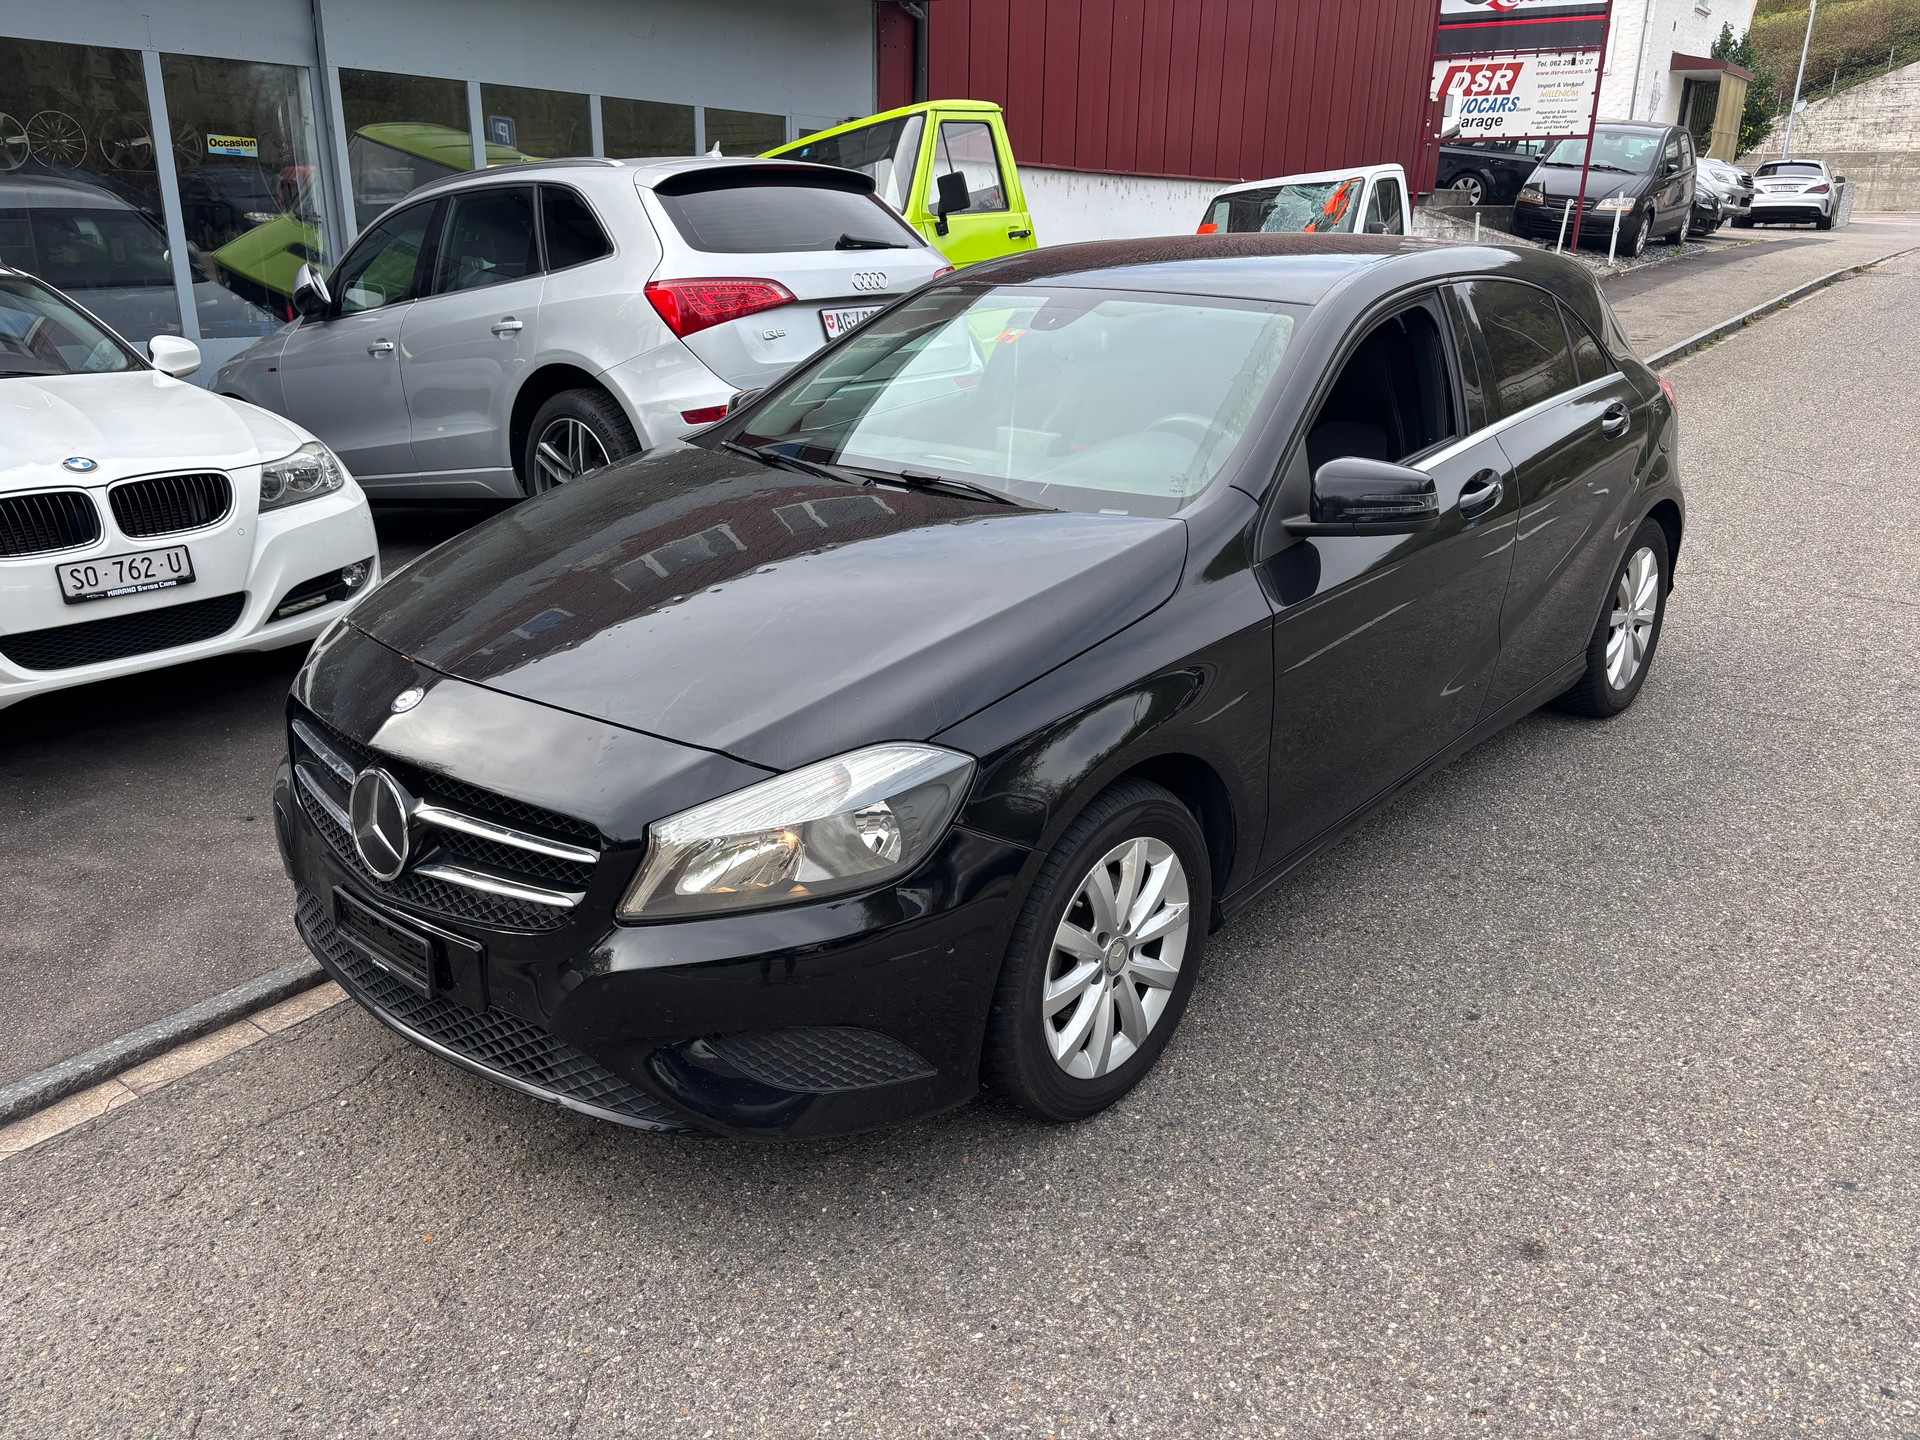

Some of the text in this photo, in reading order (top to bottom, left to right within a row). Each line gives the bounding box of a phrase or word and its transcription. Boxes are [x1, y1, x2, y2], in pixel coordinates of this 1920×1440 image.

[1447, 69, 1514, 93] DSR
[1460, 116, 1504, 131] arage
[209, 138, 257, 147] Occasion
[763, 329, 787, 341] Q5
[588, 411, 614, 443] ICEGRIP
